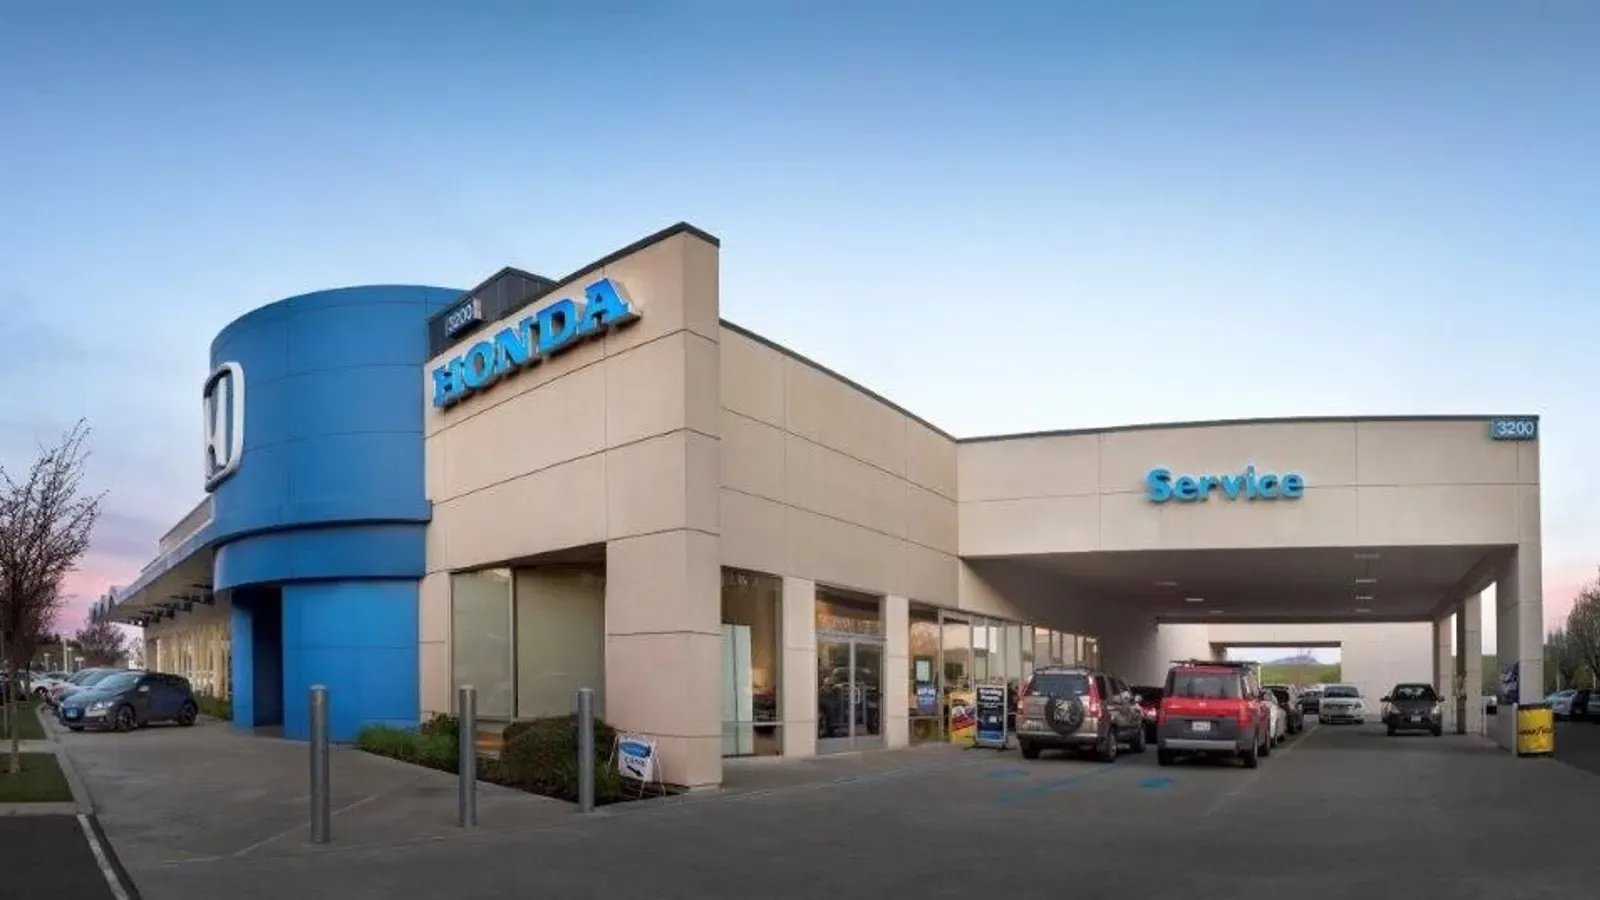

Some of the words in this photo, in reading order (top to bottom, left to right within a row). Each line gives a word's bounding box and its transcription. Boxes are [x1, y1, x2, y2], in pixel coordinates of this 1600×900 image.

[448, 303, 473, 334] 3200
[433, 277, 634, 408] HONDA
[1497, 420, 1534, 435] 3200
[1146, 465, 1305, 503] Service
